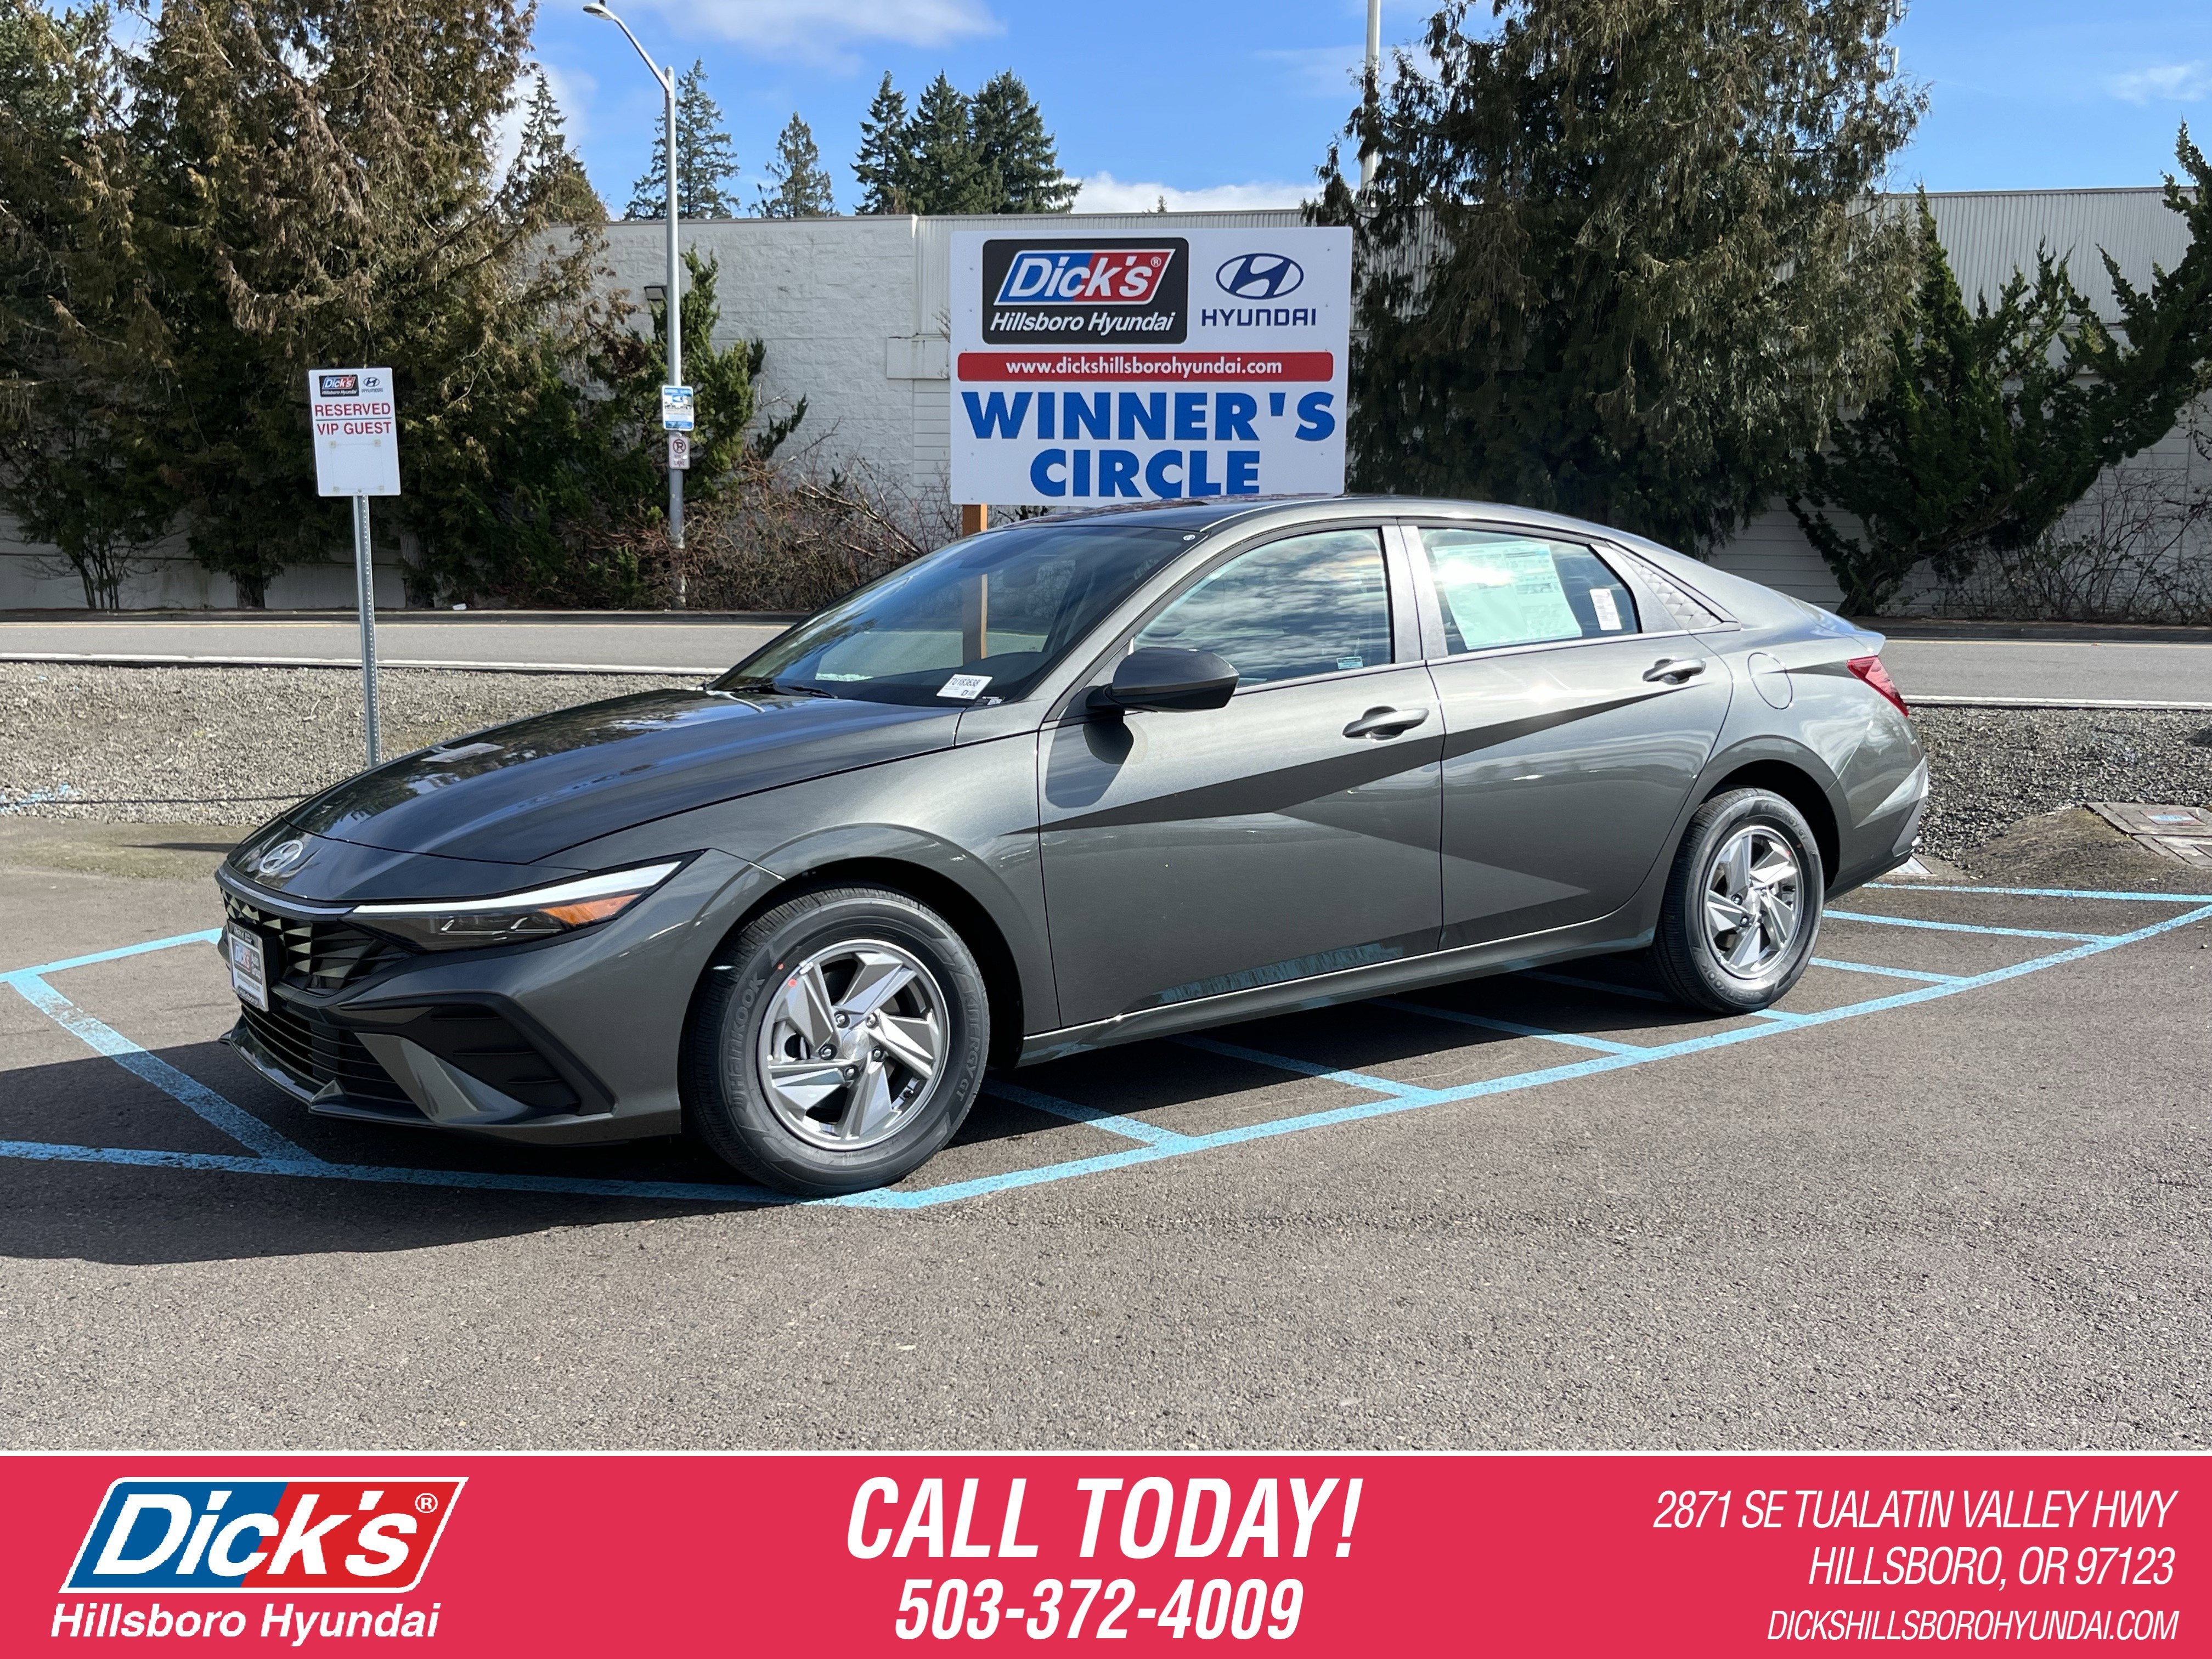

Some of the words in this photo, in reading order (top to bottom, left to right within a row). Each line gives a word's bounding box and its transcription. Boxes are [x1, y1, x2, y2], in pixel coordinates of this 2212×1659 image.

[990, 312, 1085, 331] Hillsboro
[1087, 312, 1176, 336] Hyundai
[1201, 308, 1316, 326] HYUNDAI
[1006, 356, 1282, 379] www.dickshillsborohyundai.com
[314, 403, 391, 417] RESERVED
[961, 392, 1335, 441] WINNER'S
[317, 423, 339, 436] VIP
[343, 421, 392, 435] GUEST
[1030, 449, 1260, 499] CIRCLE
